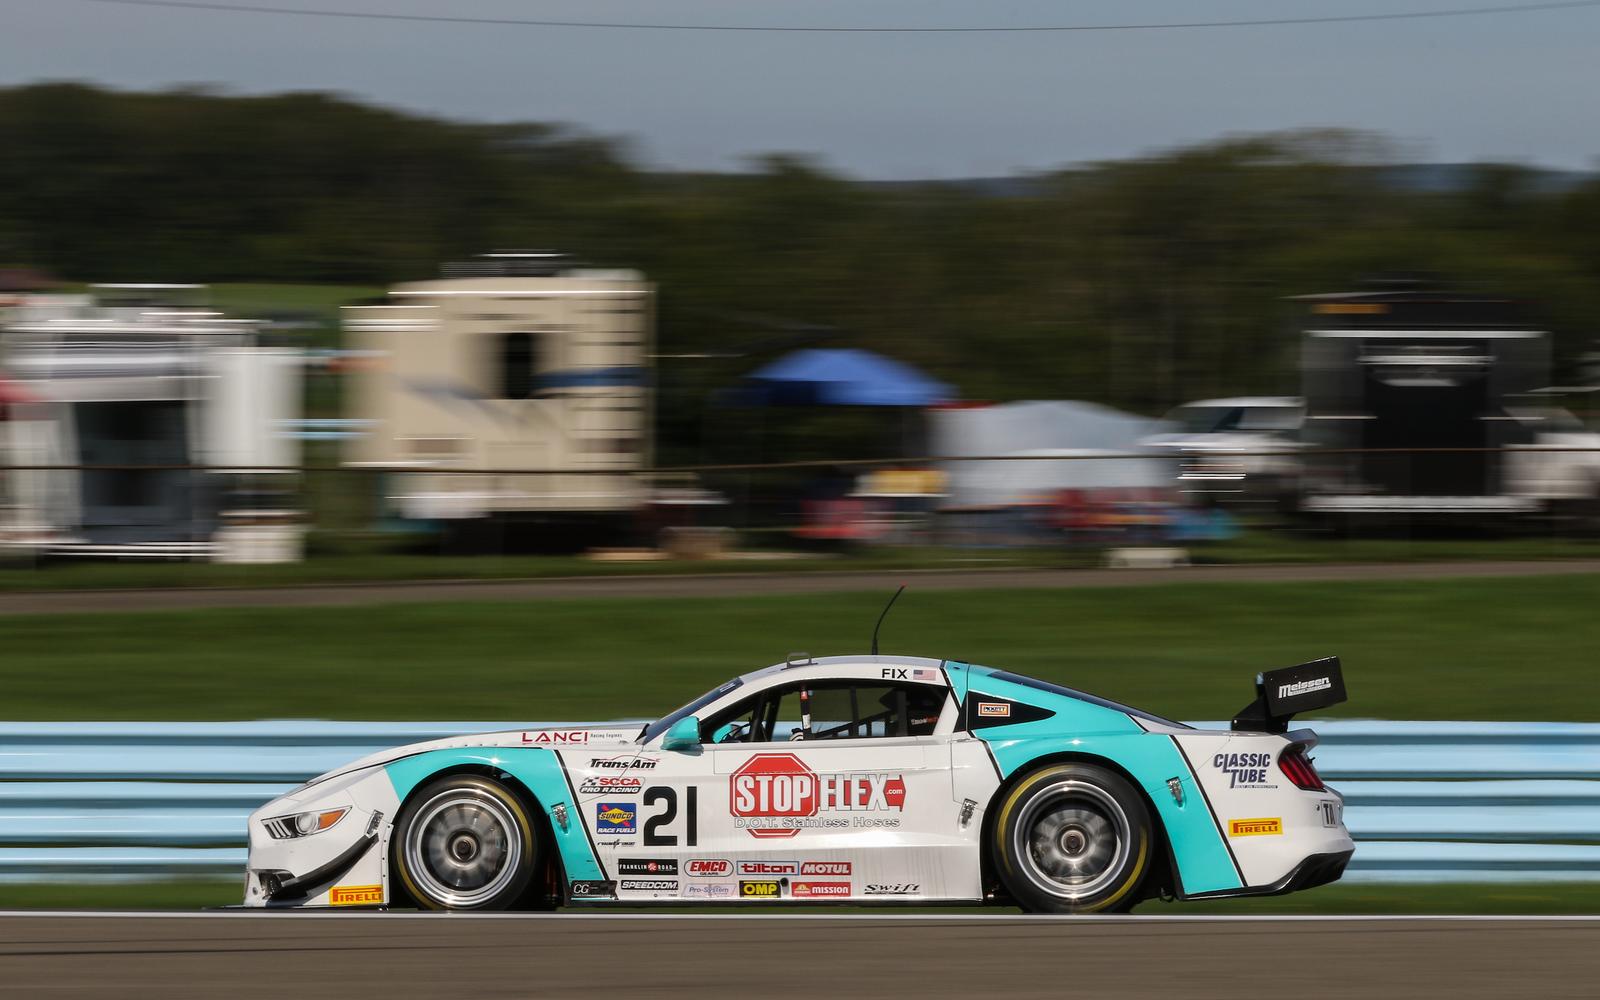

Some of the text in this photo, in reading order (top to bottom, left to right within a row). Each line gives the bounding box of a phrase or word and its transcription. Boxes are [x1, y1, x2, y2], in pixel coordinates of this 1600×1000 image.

[882, 668, 908, 679] FIX
[521, 732, 588, 742] LANCI
[1214, 753, 1270, 773] CLASSIC
[600, 777, 641, 786] SCCA
[1230, 769, 1266, 789] TUBE
[736, 775, 811, 812] STOP
[820, 774, 889, 811] FLEX
[600, 812, 633, 820] SUNOCO
[643, 785, 697, 847] 21
[734, 817, 900, 828] D.O.T. Stainless Hoses
[1233, 821, 1278, 833] PIRELLI
[690, 861, 727, 872] EMCO
[741, 863, 795, 873] tilton
[802, 864, 849, 873] MOTUL
[743, 884, 778, 895] OMP
[864, 884, 920, 892] Swift
